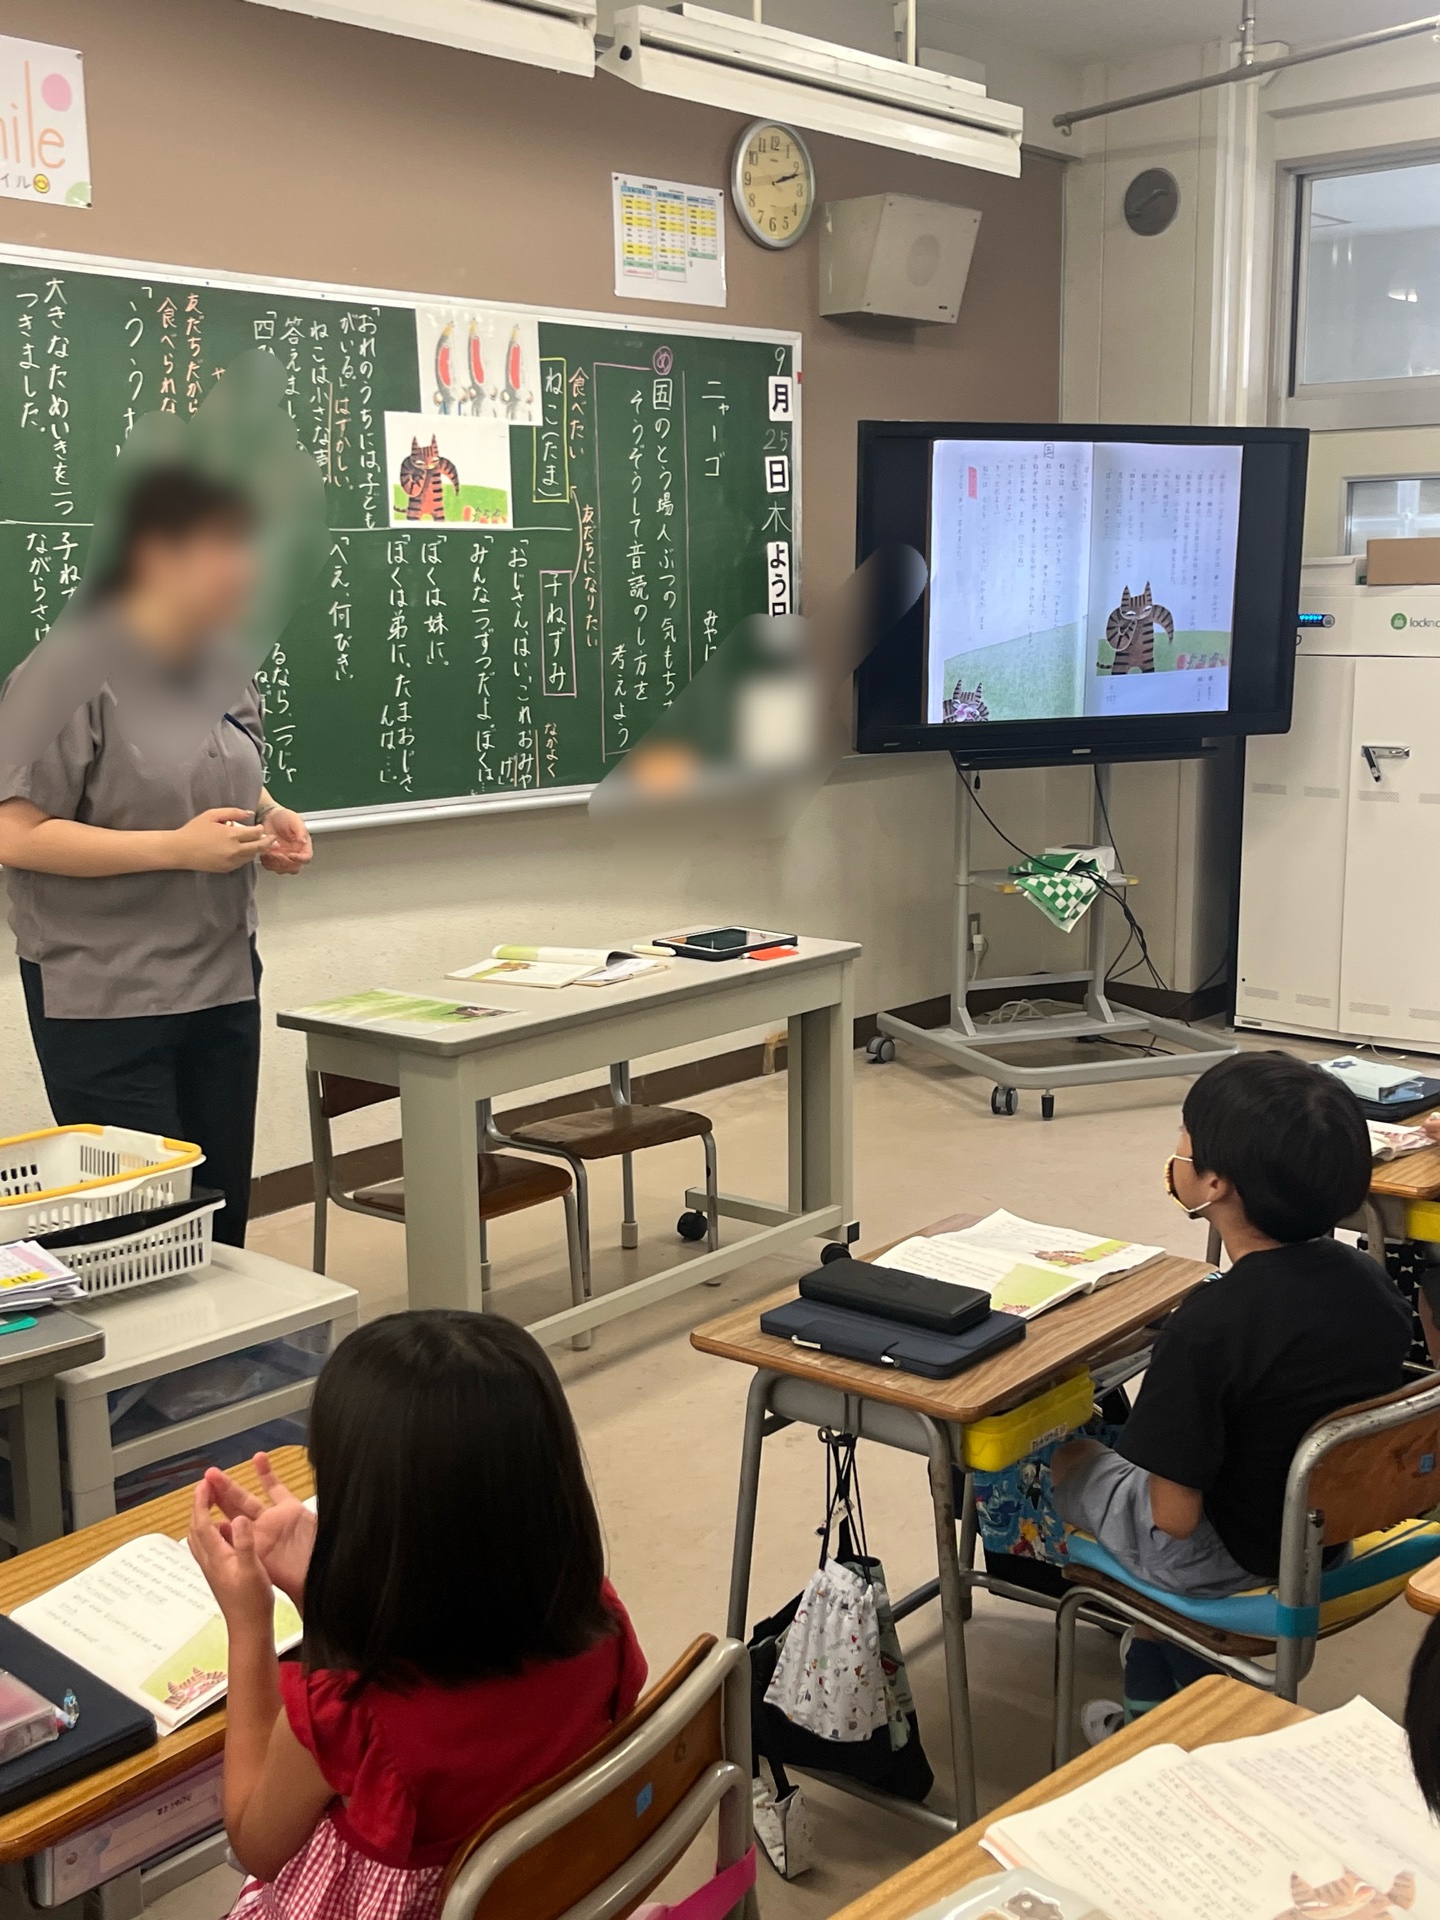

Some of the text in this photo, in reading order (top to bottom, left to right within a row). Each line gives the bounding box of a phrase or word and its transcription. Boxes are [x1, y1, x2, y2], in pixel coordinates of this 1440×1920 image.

[759, 137, 766, 153] 11
[769, 136, 780, 151] 12
[785, 144, 790, 159] 1
[748, 150, 759, 166] 10
[744, 171, 752, 186] 9
[796, 183, 804, 198] 3
[748, 193, 756, 208] 8
[757, 210, 765, 224] 7
[791, 202, 798, 216] 4
[769, 217, 777, 232] 6
[782, 216, 789, 231] 5
[16, 293, 46, 433] つきました。
[43, 277, 74, 516] 大きなためいきを一つ
[568, 367, 590, 459] 食べたい
[702, 380, 730, 477] ニャーゴ
[626, 389, 650, 701] そうぞうして音読のし方を
[582, 504, 600, 647] 友だちになりたい
[544, 573, 568, 691] 子ねずみ
[610, 643, 630, 748] 考えよう
[544, 723, 559, 778] なかよく
